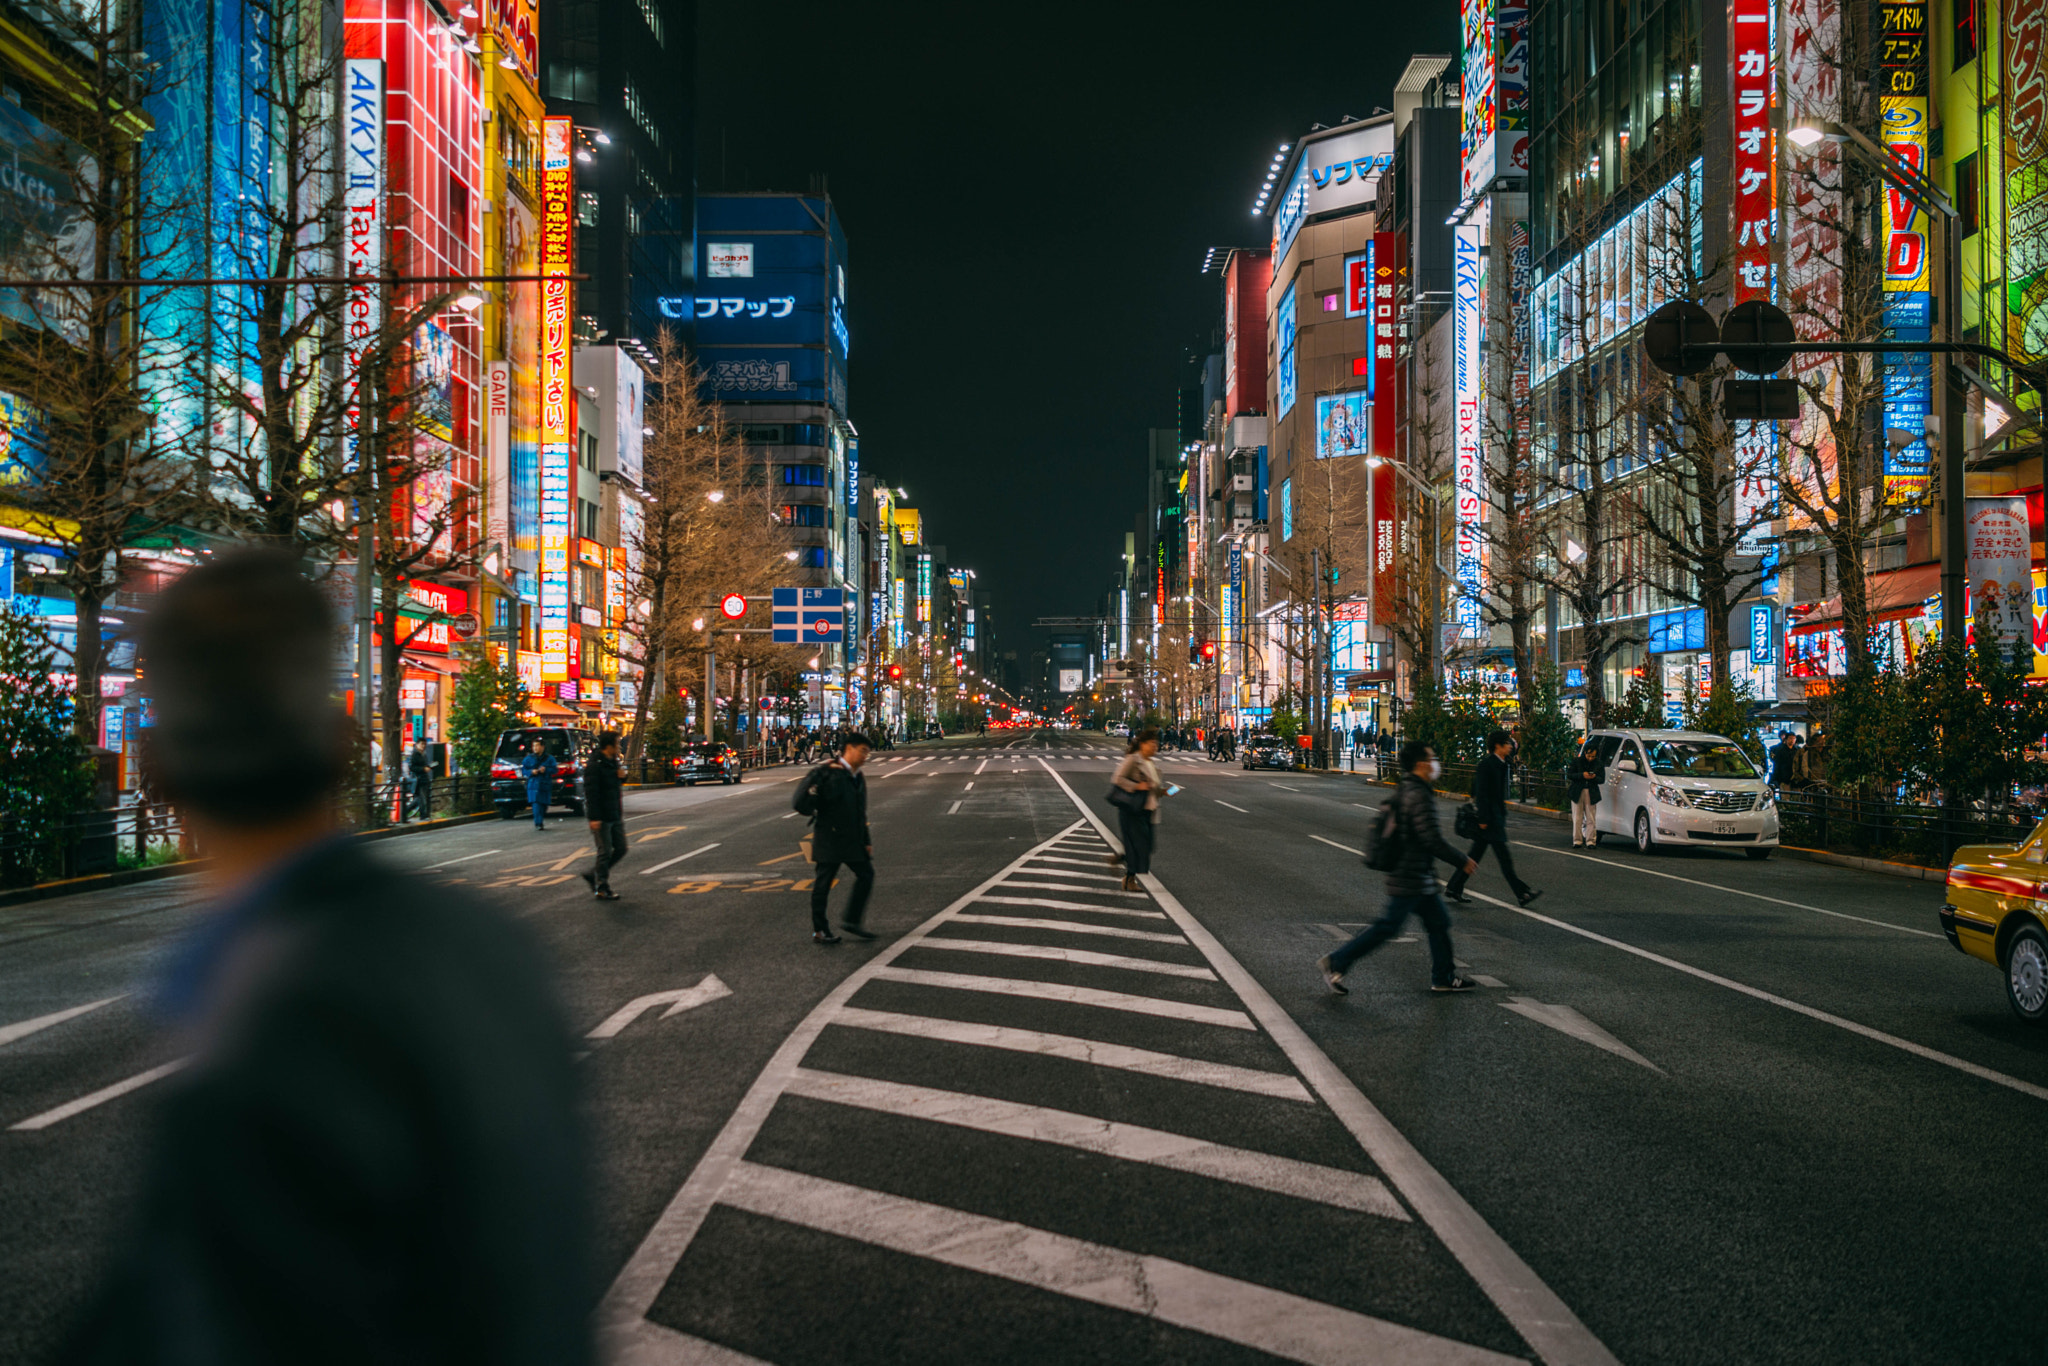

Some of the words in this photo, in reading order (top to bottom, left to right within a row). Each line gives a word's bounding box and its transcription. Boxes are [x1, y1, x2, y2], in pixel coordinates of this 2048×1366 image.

[1882, 6, 1923, 30] アイドル
[1884, 39, 1923, 60] アニメ
[1891, 70, 1915, 92] CD
[351, 66, 377, 169] AKKY
[546, 172, 567, 181] DVD
[1312, 155, 1392, 188] ソフマッ
[549, 202, 564, 211] CD
[1884, 141, 1926, 281] DVD
[1457, 234, 1477, 312] AKKY
[1377, 284, 1393, 359] 坂口電熱
[1457, 292, 1467, 393] INTERNATIONAL
[491, 370, 506, 417] GAME
[1460, 396, 1477, 491] Tax-free
[849, 461, 858, 505] ソフマップ
[1458, 497, 1477, 553] Shop
[1968, 507, 1991, 525] WELCOME
[1997, 507, 2027, 525] AKIHABARA
[1385, 519, 1393, 565] SAKAGUCHI
[1971, 549, 2028, 560] 元気なアキバ
[1232, 553, 1241, 587] ソフマップ
[727, 600, 743, 612] 50
[803, 589, 823, 599] 上野
[1755, 611, 1768, 659] カラオケ
